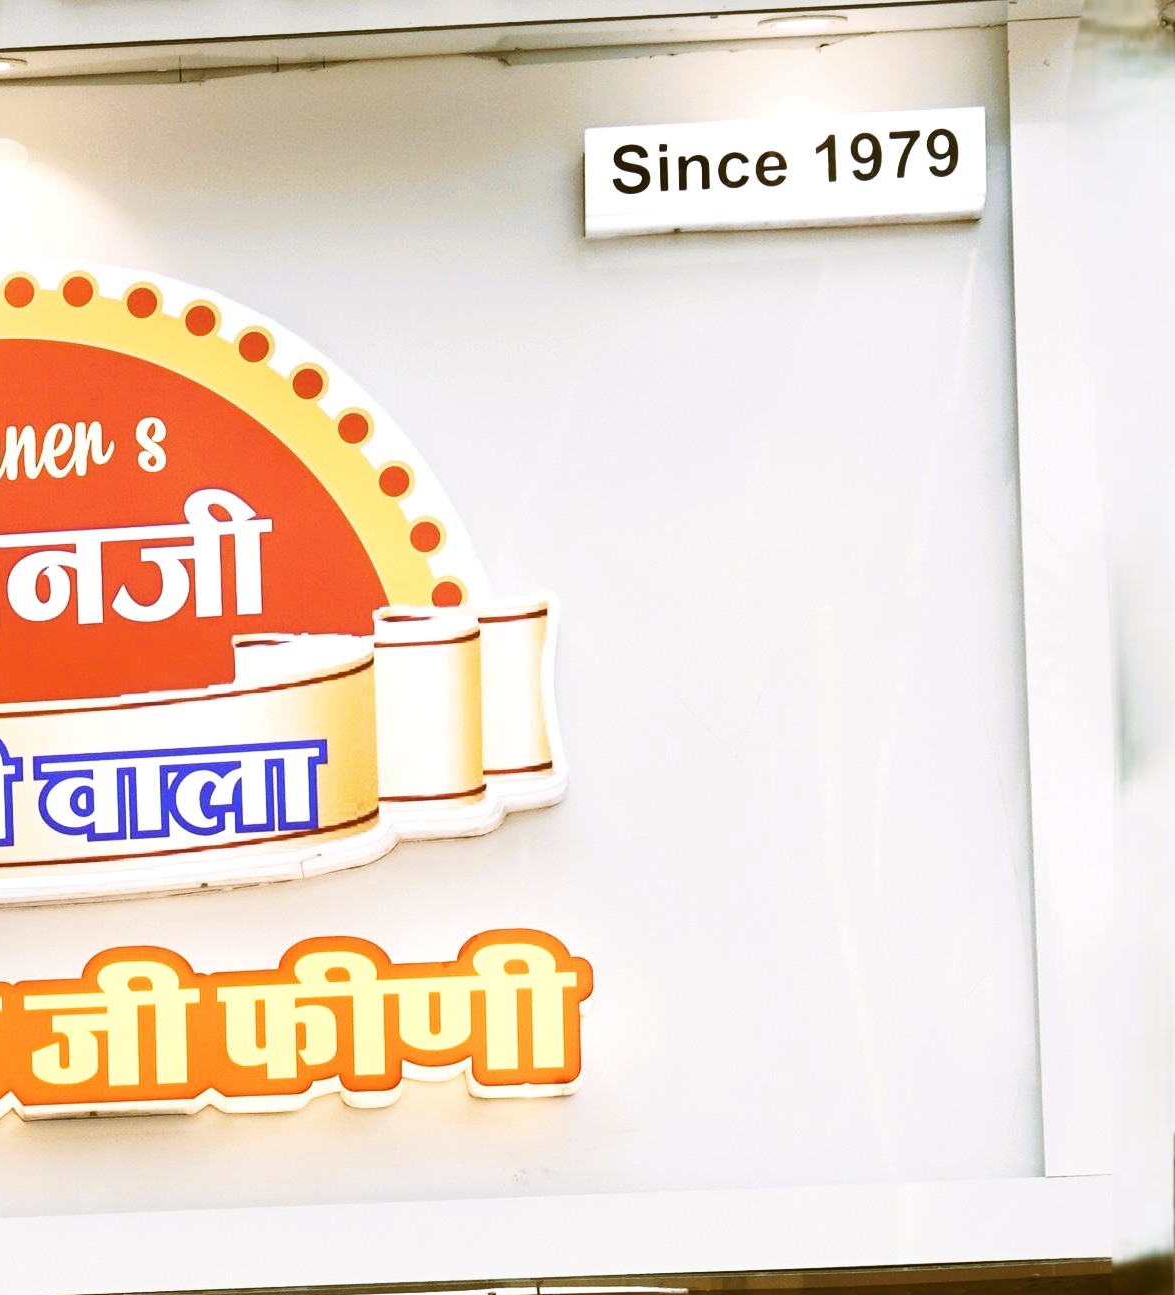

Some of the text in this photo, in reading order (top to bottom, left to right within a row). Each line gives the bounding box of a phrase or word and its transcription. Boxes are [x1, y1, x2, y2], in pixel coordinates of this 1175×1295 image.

[613, 129, 960, 195] Since 1979
[33, 739, 327, 842] वाला
[24, 960, 200, 1086] जी
[217, 943, 577, 1080] फीणी
